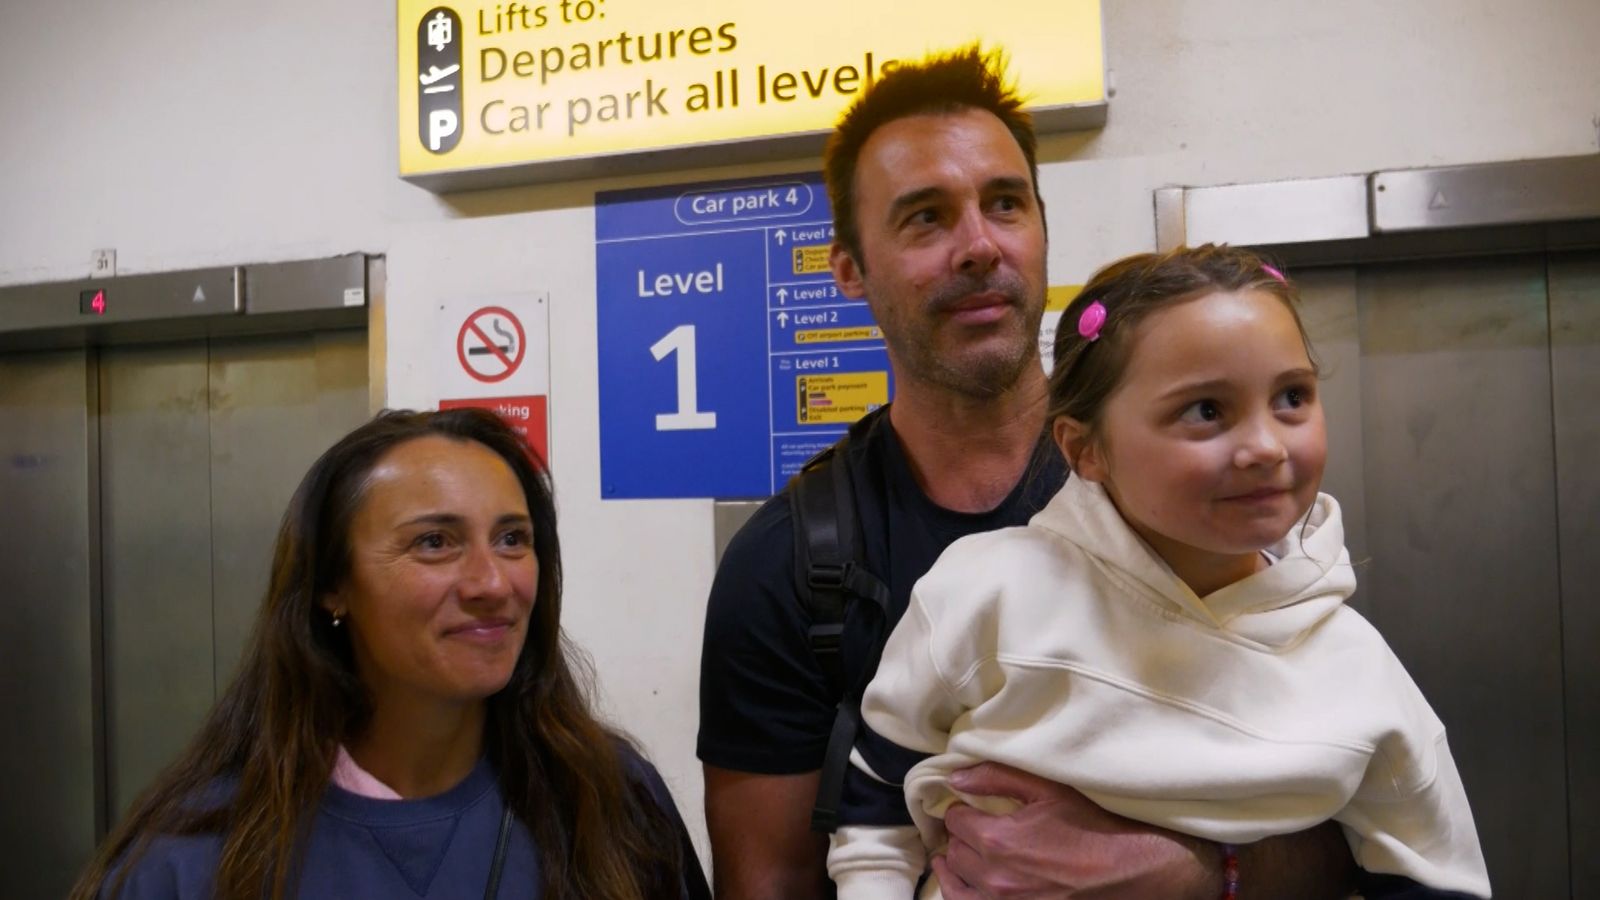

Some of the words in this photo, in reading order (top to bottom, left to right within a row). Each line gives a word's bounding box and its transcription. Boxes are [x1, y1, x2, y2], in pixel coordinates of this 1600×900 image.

[479, 3, 548, 36] Lifts
[560, 0, 605, 23] to:
[480, 21, 737, 86] Departures
[480, 99, 551, 135] Car
[567, 79, 670, 137] park
[685, 68, 740, 113] all
[429, 109, 458, 151] P
[692, 196, 727, 214] Car
[732, 189, 780, 215] park
[785, 187, 799, 206] 4
[792, 228, 825, 241] Level
[828, 227, 836, 238] 4
[638, 262, 724, 297] Level
[793, 287, 827, 300] Level
[829, 286, 838, 298] 3
[91, 291, 105, 315] 4
[794, 311, 827, 324] Level
[830, 311, 839, 323] 2
[796, 357, 829, 369] Level
[832, 356, 839, 368] 1
[649, 324, 717, 431] 1
[837, 383, 868, 391] payment
